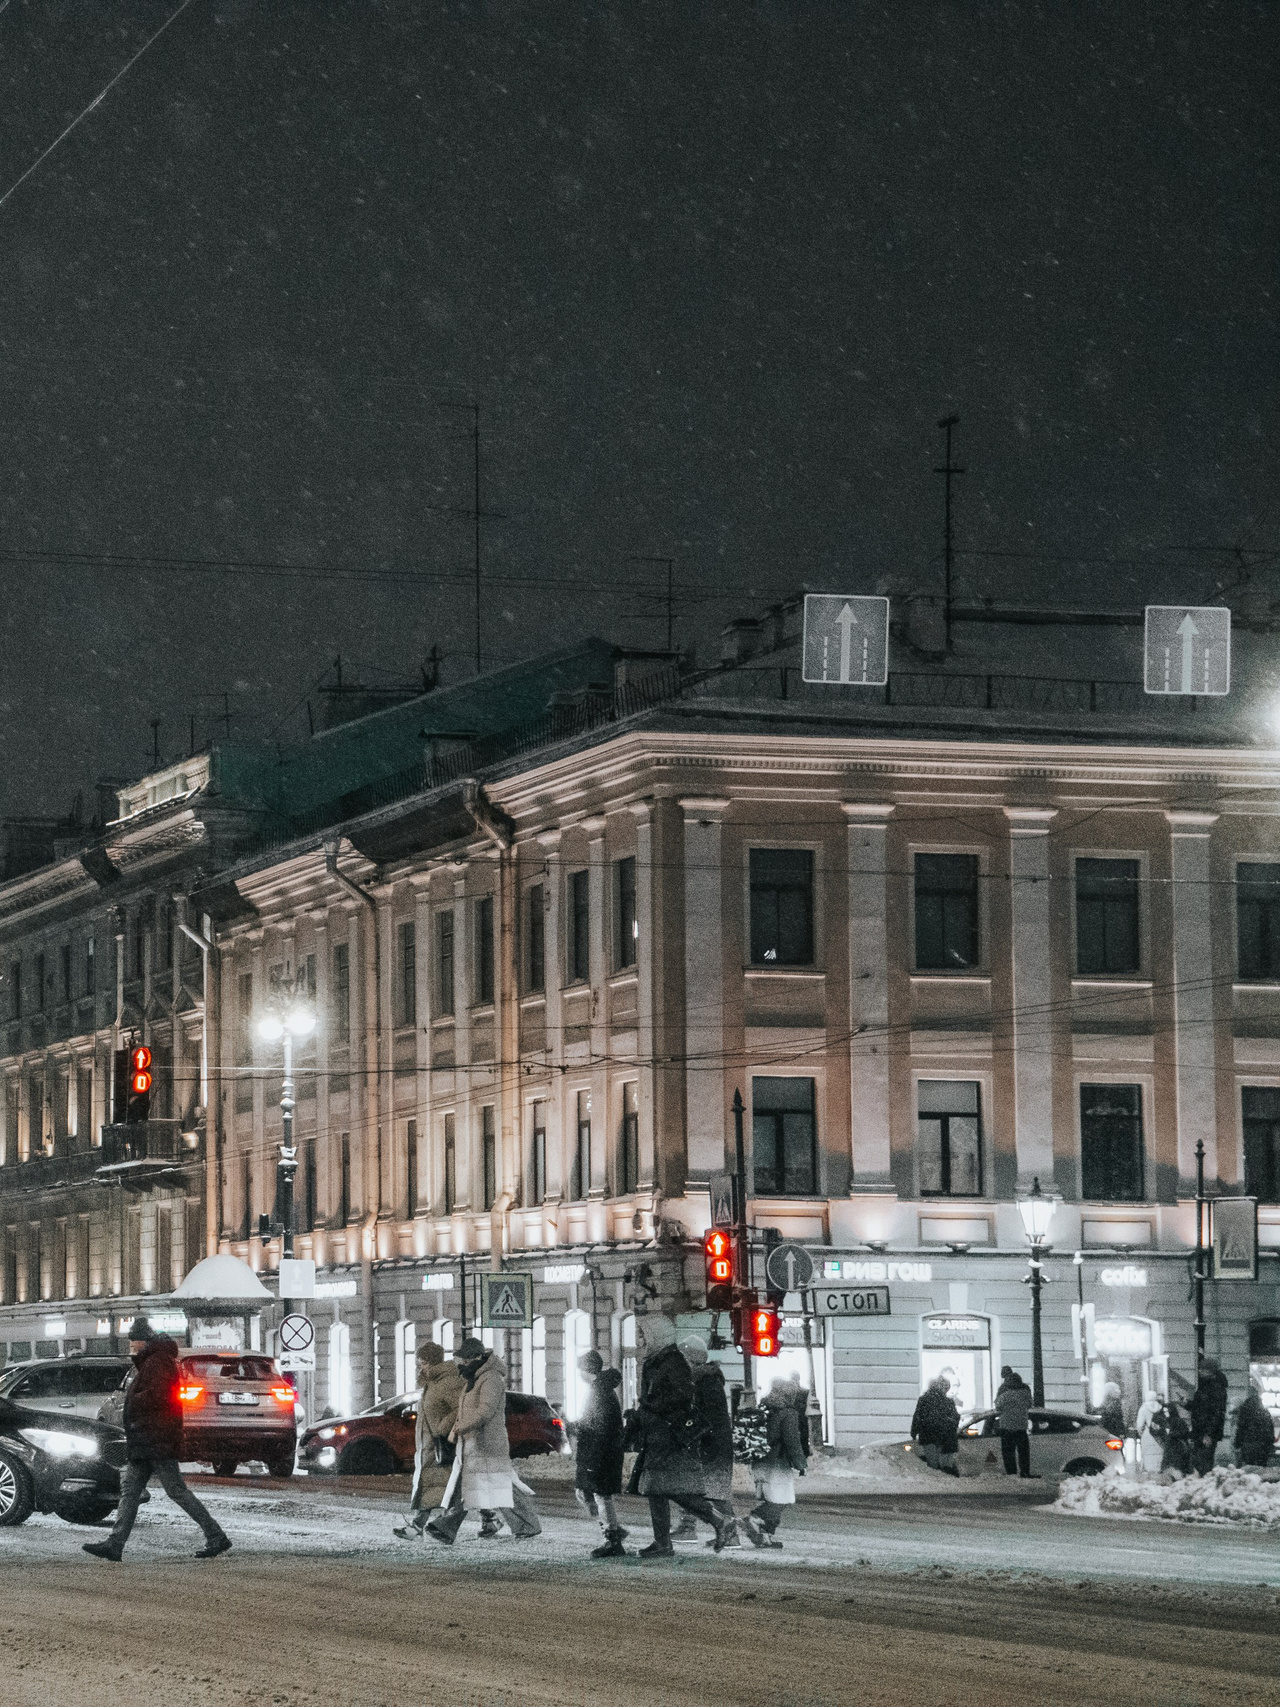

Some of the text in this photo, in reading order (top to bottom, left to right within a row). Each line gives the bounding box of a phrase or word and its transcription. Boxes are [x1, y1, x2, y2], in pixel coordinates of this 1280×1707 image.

[843, 1262, 932, 1282] РИВ ГОШ
[826, 1293, 879, 1311] СТОП
[927, 1319, 980, 1330] CLARINS
